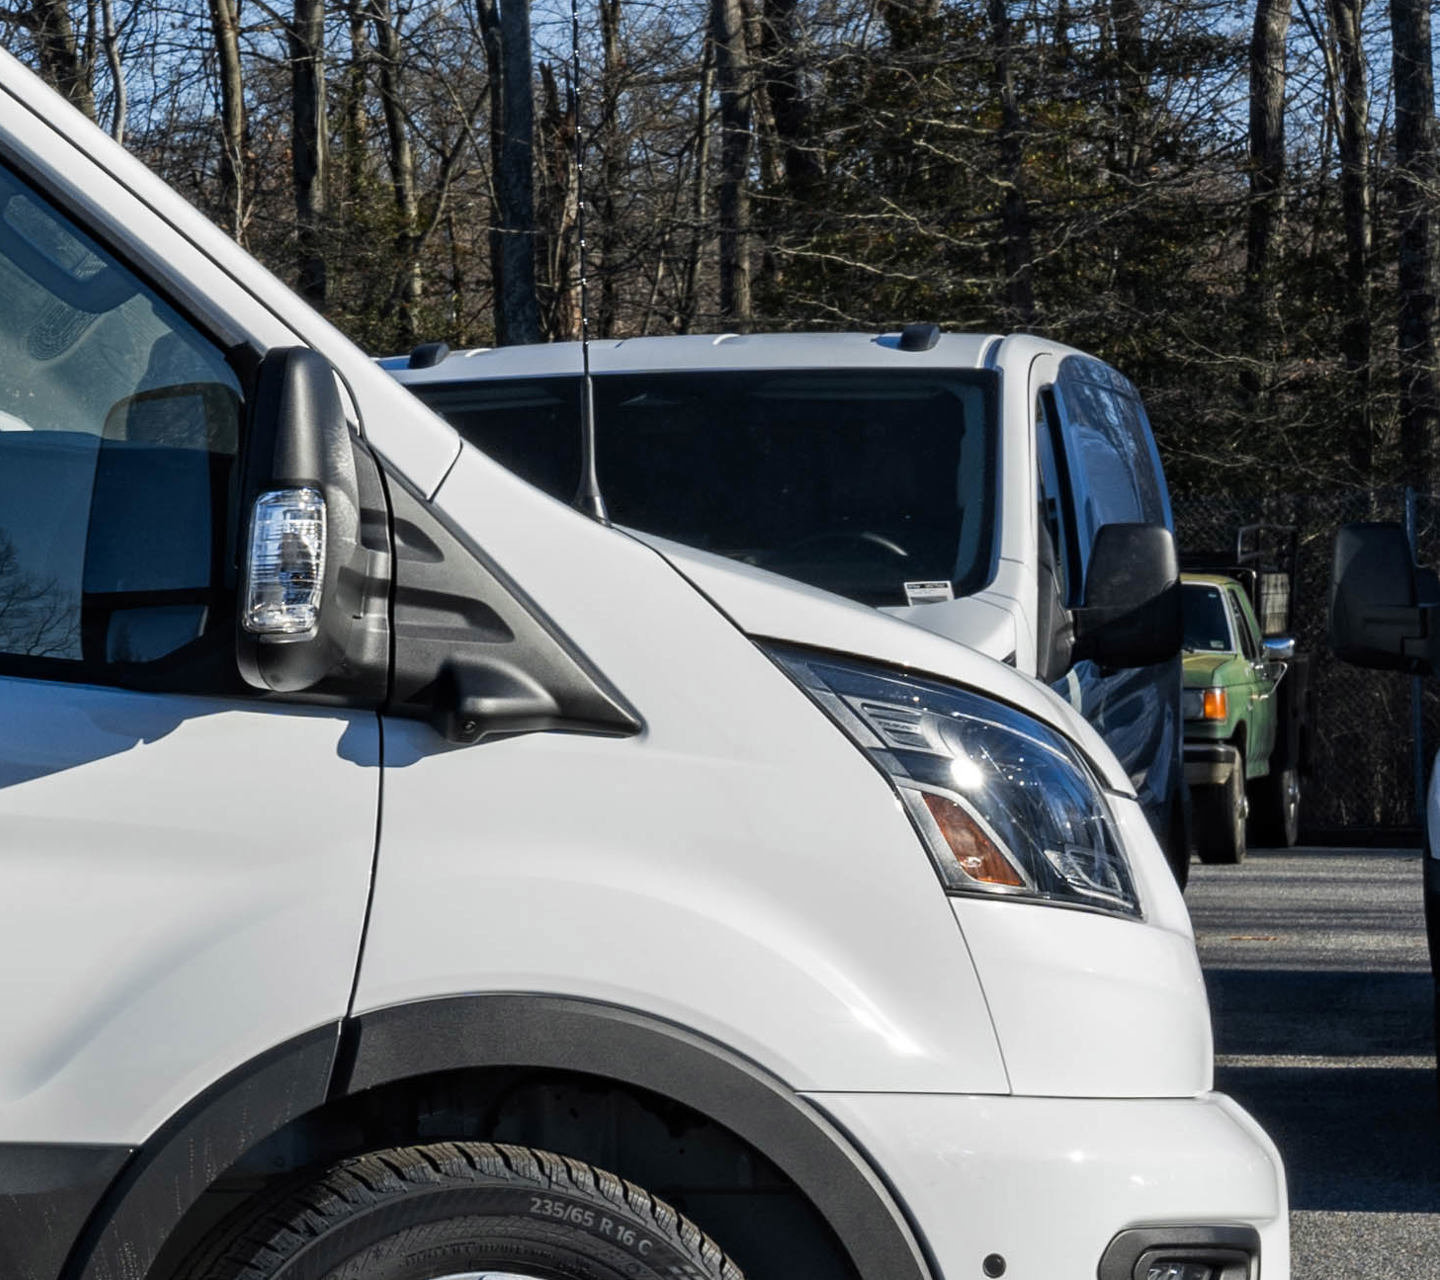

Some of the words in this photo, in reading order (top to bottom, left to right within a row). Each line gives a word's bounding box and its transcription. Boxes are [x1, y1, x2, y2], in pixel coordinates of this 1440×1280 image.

[530, 1197, 595, 1227] 235/65
[599, 1217, 614, 1235] R
[616, 1225, 637, 1247] 16
[638, 1239, 654, 1256] C
